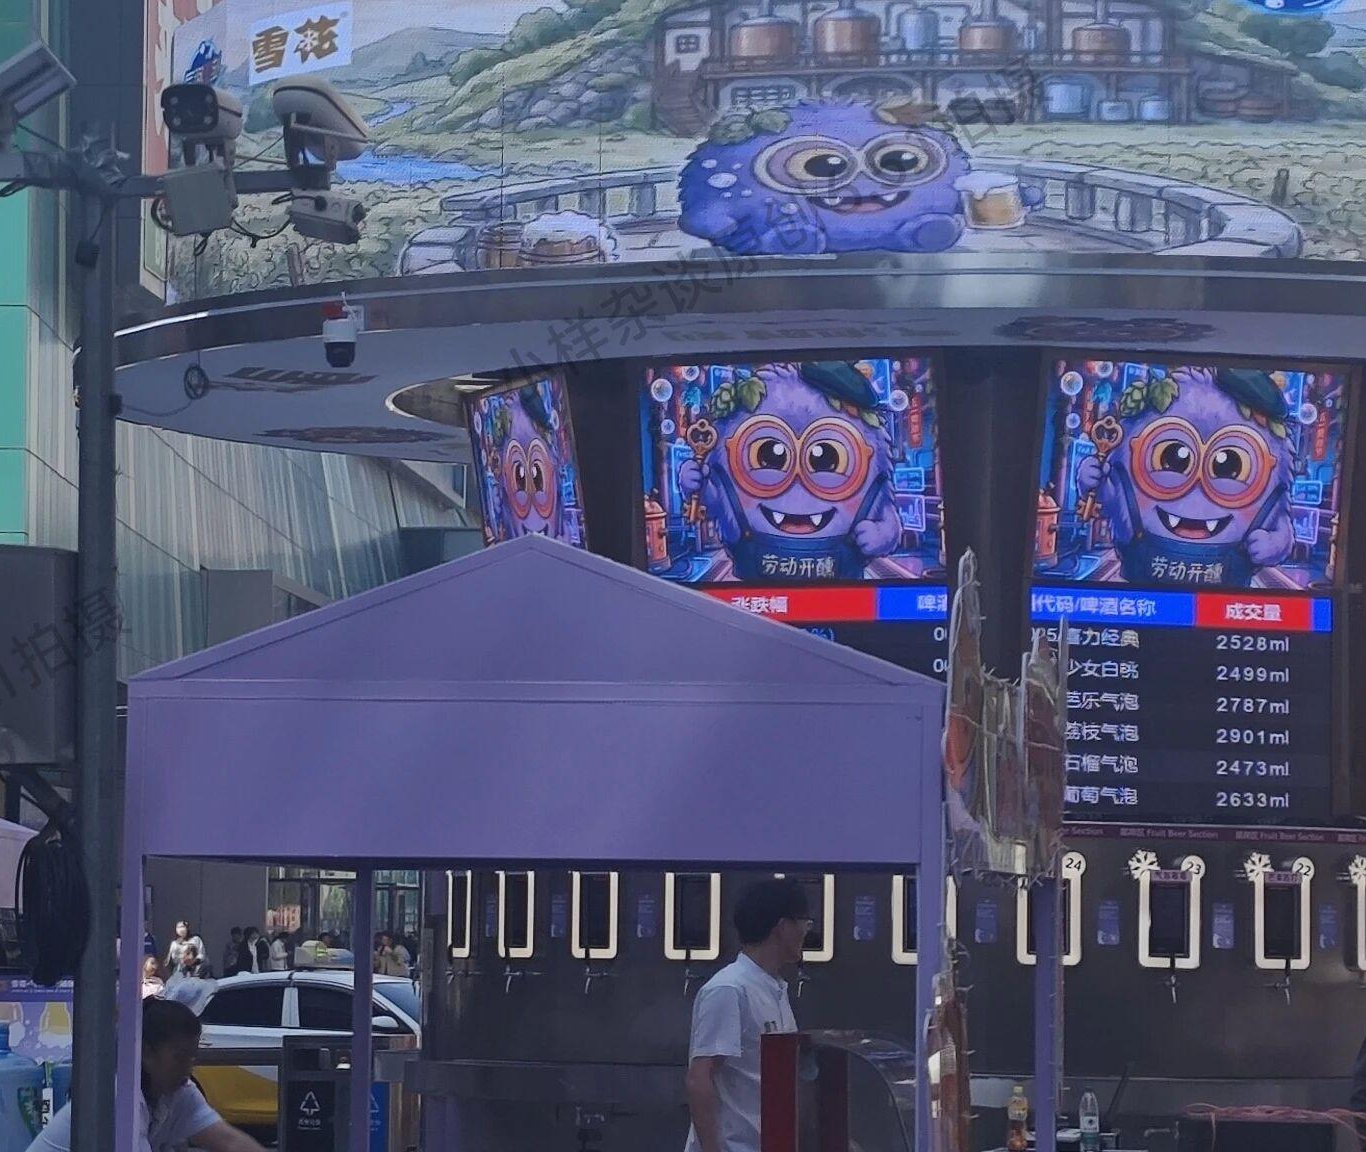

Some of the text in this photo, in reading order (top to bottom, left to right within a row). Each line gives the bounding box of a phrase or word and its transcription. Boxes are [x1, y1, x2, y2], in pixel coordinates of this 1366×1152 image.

[252, 15, 341, 74] 雪花
[1031, 593, 1156, 617] 代码/啤酒名称
[1224, 603, 1283, 622] 成交量
[1215, 634, 1290, 652] 2528ml
[1215, 665, 1290, 683] 2499ml
[1215, 697, 1290, 715] 2787ml
[1215, 728, 1290, 746] 2901ml
[1215, 759, 1290, 777] 2473ml
[1215, 791, 1290, 809] 2633ml
[1065, 857, 1083, 871] 24
[1186, 861, 1202, 875] 23
[1297, 862, 1312, 877] 22
